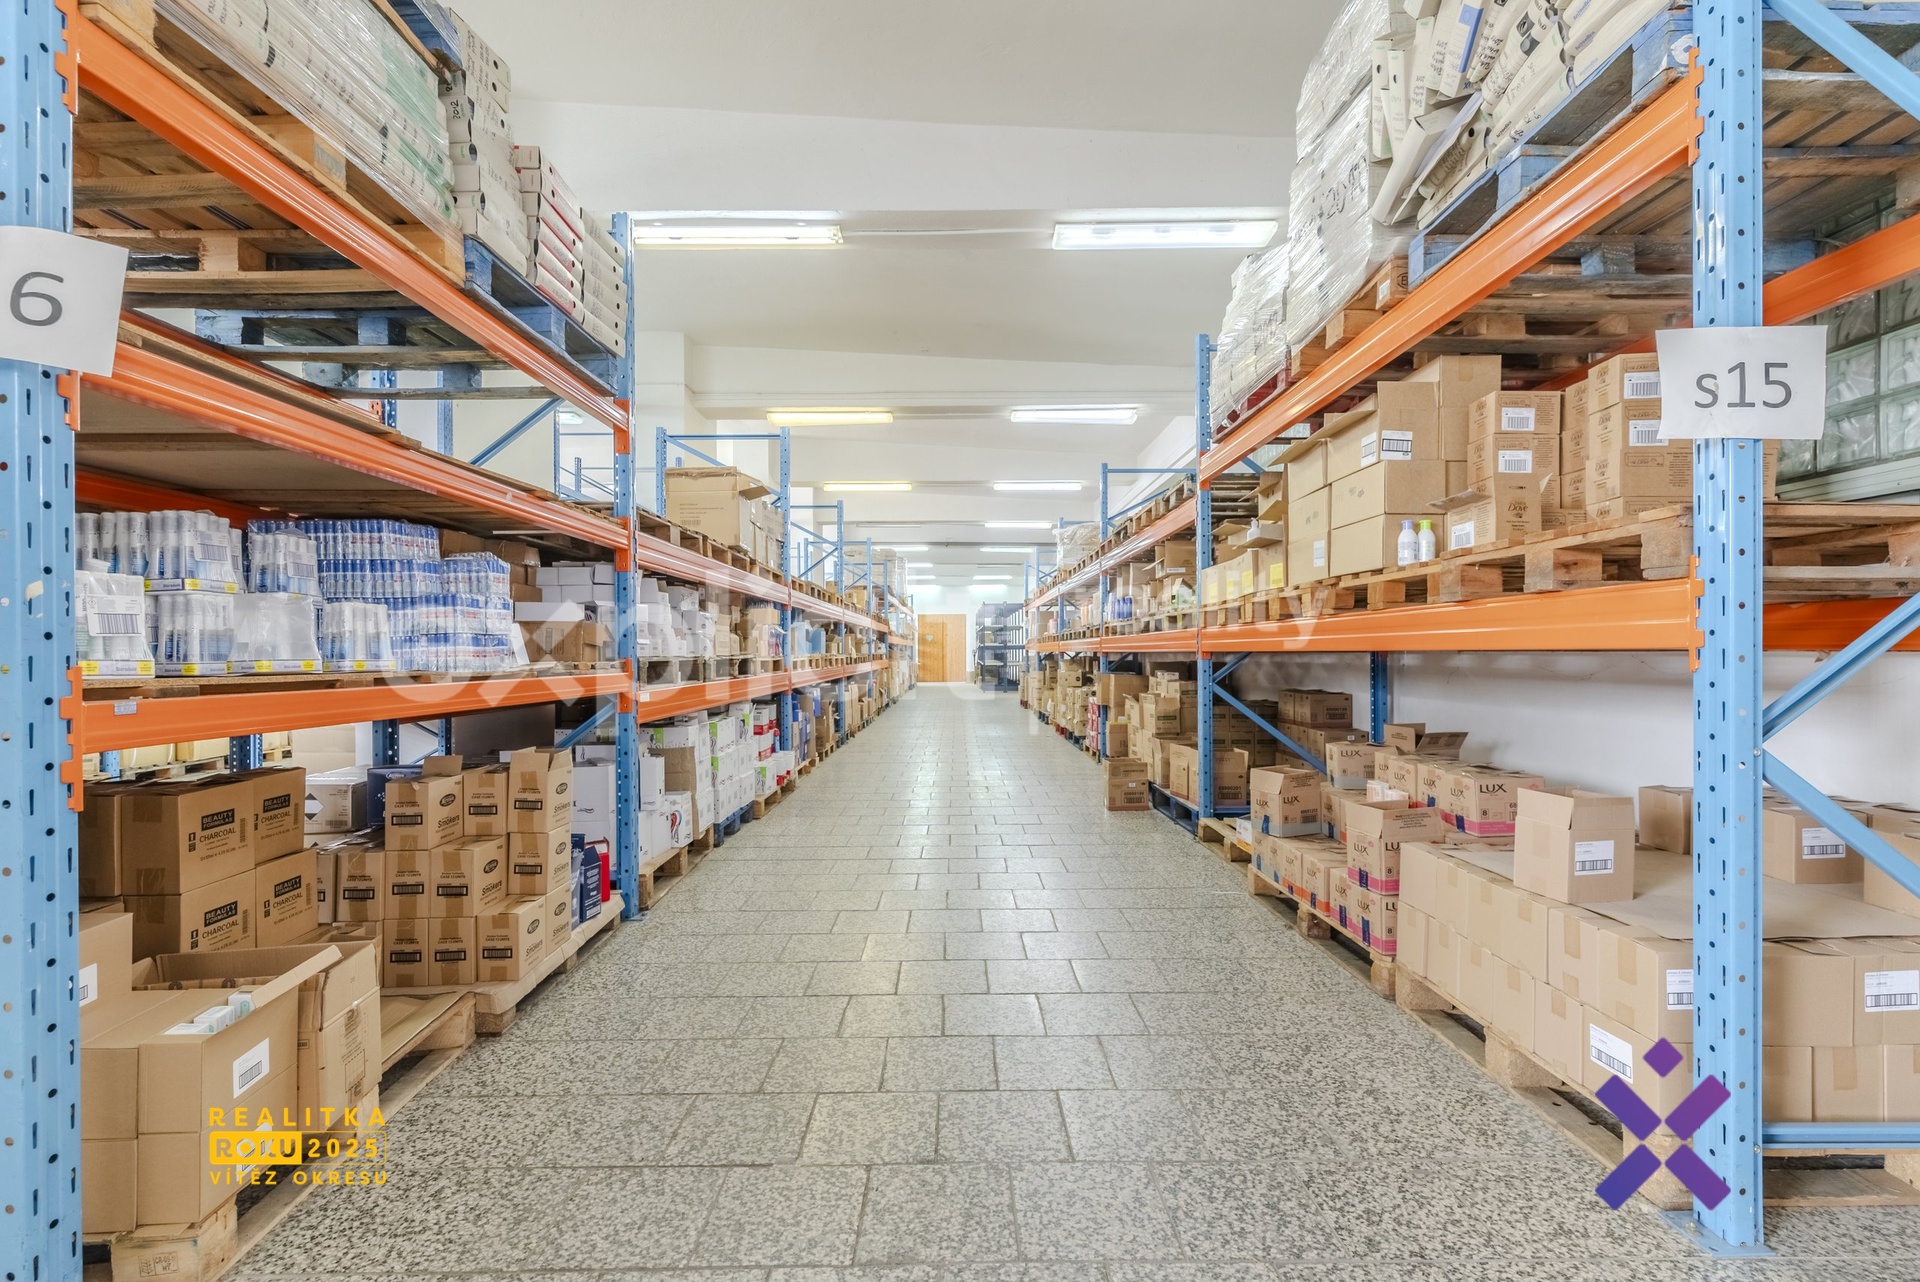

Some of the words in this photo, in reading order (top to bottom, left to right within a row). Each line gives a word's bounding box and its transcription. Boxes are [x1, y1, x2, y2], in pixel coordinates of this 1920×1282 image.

[450, 99, 461, 119] 2012
[10, 271, 64, 327] 6
[1694, 361, 1792, 409] s15
[1507, 503, 1528, 512] Dove
[1340, 749, 1362, 758] LUX
[1394, 772, 1407, 782] LUX
[1423, 777, 1437, 789] LUX
[1450, 787, 1465, 799] LUX
[1479, 783, 1507, 793] LUX
[264, 795, 290, 807] BEAUTY
[264, 801, 289, 811] FORMULAS
[1256, 799, 1270, 808] LUX
[1283, 795, 1300, 804] LUX
[553, 801, 571, 814] Smokers
[202, 810, 234, 824] BEAUTY
[203, 816, 233, 829] FORMULAS
[260, 810, 291, 824] CHARCOAL
[437, 815, 460, 829] Smokers
[199, 827, 237, 843] CHARCOAL
[1353, 842, 1369, 856] LUX
[1385, 841, 1401, 852] LU
[553, 862, 570, 875] Smokers
[1306, 867, 1318, 880] LUX
[275, 877, 300, 892] BEAUTY
[275, 884, 300, 896] FORMULAS
[481, 880, 503, 897] Smokers
[1335, 883, 1348, 897] LUX
[272, 892, 303, 909] CHARCOAL
[1357, 898, 1372, 914] LUX
[205, 903, 236, 920] BEAUTY
[206, 910, 236, 925] FORMULAS
[201, 919, 239, 939] CHARCOAL
[552, 921, 570, 937] Smokers
[525, 939, 543, 957] Smokers
